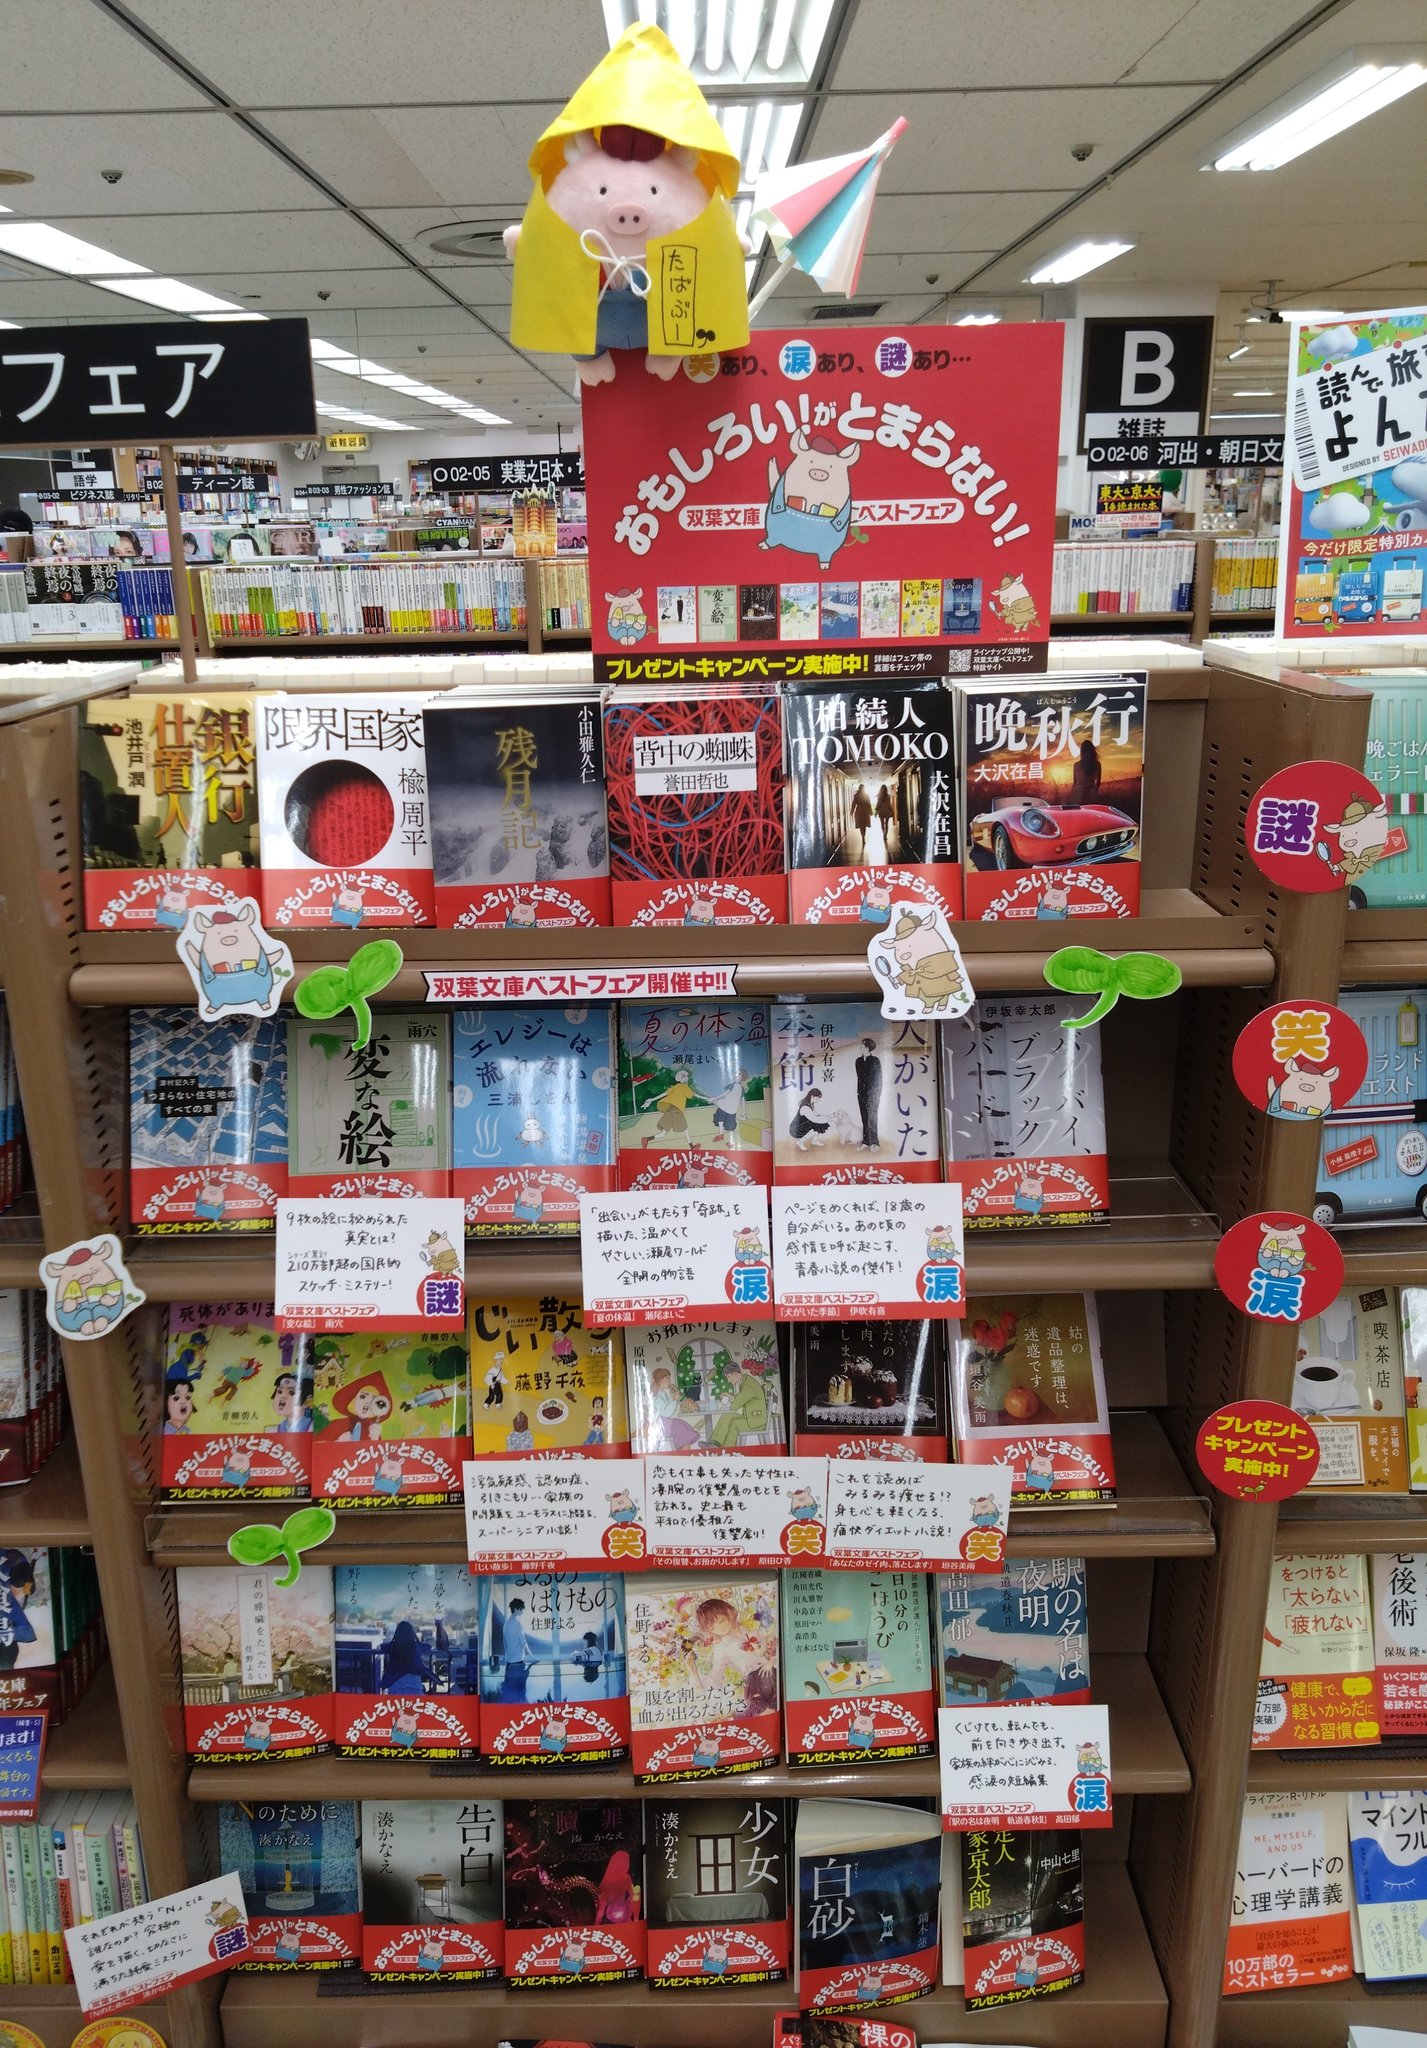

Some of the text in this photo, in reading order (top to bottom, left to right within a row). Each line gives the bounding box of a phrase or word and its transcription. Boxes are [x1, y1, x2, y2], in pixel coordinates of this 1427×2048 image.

[668, 249, 696, 342] たばぶー
[1120, 330, 1175, 406] B
[2, 343, 226, 423] フェア
[1118, 418, 1166, 438] 雑誌
[328, 437, 367, 448] 避難器具
[1157, 440, 1284, 466] 河出・朝日文
[1342, 457, 1372, 473] DESIGNED
[1372, 455, 1380, 464] BY
[73, 474, 98, 488] 語学
[191, 476, 256, 491] ティーン誌
[308, 486, 330, 495] B03-03
[334, 484, 391, 496] 男性ファッション誌
[70, 490, 115, 500] ビジネス誌
[436, 517, 477, 527] CYANMAN
[686, 501, 957, 528] 双葉文庫 ベストフェア
[1303, 533, 1427, 557] 今だけ限定特別カ
[606, 655, 869, 681] プレゼントキャンペーン実施中!
[873, 653, 933, 664] 詳細はフェア帯の
[873, 662, 926, 673] 裏面をチェック!
[973, 655, 1034, 664] 双葉文庫ベストフェア
[815, 696, 927, 733] 相続人
[263, 706, 426, 752] 限界国家
[975, 692, 1139, 761] 晩秋行
[577, 705, 597, 785] 小田雅久仁
[635, 735, 755, 768] 背中の蜘蛛
[792, 730, 950, 766] TOMOKO
[149, 703, 197, 839] 仕置人
[195, 706, 256, 824] 銀行
[974, 762, 1044, 783] 大沢在昌
[495, 726, 542, 851] 残月記
[663, 772, 730, 793] 誉田哲也
[929, 770, 952, 857] 大沢在昌
[1256, 799, 1318, 855] 謎
[433, 973, 728, 999] 双葉文庫ベストフェア開催中!!
[985, 1004, 1057, 1018] 伊坂幸太郎
[408, 1025, 438, 1039] 雨穴
[469, 1019, 593, 1058] エレジーは
[639, 1006, 770, 1058] 夏の体温
[1273, 1010, 1330, 1062] 笑
[776, 1008, 815, 1093] 季節
[820, 1023, 836, 1083] 伊吹有喜
[158, 1078, 197, 1088] 津村記久子
[1010, 1032, 1042, 1149] ブラック
[148, 1088, 237, 1101] つまらない住宅地の
[337, 1034, 398, 1168] 変な絵
[487, 1092, 579, 1108] 三浦しをん
[164, 1104, 214, 1116] すべての家
[591, 1201, 741, 1223] 「出会い」がもたらす「奇跡」を
[785, 1200, 926, 1215] ページをめくれば、18歳の
[286, 1211, 408, 1226] 9枚の絵に秘められた
[786, 1220, 906, 1237] 自分がいる。あの頃の
[345, 1230, 396, 1246] 真実とは?
[596, 1226, 689, 1243] 描いた、温かくて
[617, 1267, 695, 1287] 全開の物語
[795, 1260, 904, 1279] 青春小説の傑作!
[733, 1268, 768, 1303] 涙
[926, 1266, 960, 1302] 涙
[425, 1280, 462, 1315] 謎
[595, 1296, 685, 1310] 双葉文庫ベストフェア
[784, 1293, 875, 1305] 双葉文庫ベストフェア
[285, 1305, 376, 1317] 双葉文庫ベストフェア
[592, 1309, 686, 1324] 『夏の体温』 瀬尾まいこ
[780, 1305, 886, 1318] 『犬がいた季節』 伊吹有喜
[282, 1318, 344, 1329] 『変な絵』 雨穴
[1067, 1325, 1084, 1354] 姑の
[1023, 1327, 1043, 1388] 迷惑です
[1373, 1321, 1391, 1389] 喫茶店
[1046, 1327, 1069, 1410] 遺品整理は、
[514, 1371, 586, 1391] 藤野千夜
[969, 1363, 987, 1423] 垣谷美雨
[221, 1410, 259, 1421] 青柳碧人
[1216, 1415, 1307, 1438] プレゼント
[1203, 1435, 1315, 1461] キャンペーン
[1390, 1425, 1400, 1457] 至福の
[1380, 1427, 1391, 1477] エッセイで
[652, 1464, 799, 1480] 恋も仕事も失った女性は、
[1223, 1456, 1289, 1478] 実施中!
[471, 1473, 589, 1489] 浮気疑惑、認知症、
[836, 1472, 925, 1485] これを読めば
[654, 1500, 747, 1514] 訪れる。史上最も
[478, 1525, 579, 1538] スーパーシニア小説!
[654, 1514, 734, 1528] 平和で優雅な
[832, 1523, 952, 1538] 痛快ダイエット小説!
[610, 1528, 645, 1559] 笑
[787, 1524, 824, 1555] 笑
[967, 1531, 1003, 1561] 笑
[477, 1551, 563, 1561] 双葉文庫ベストフェア
[655, 1546, 742, 1557] 双葉文庫ベストフェア
[758, 1556, 792, 1566] 原田ひ香
[833, 1549, 920, 1560] 双葉文庫ベストフェア
[474, 1561, 556, 1572] 『じい散歩』 藤野千夜
[791, 1570, 823, 1579] 江國香織
[829, 1559, 976, 1571] 『あなたのゼイ肉、落とします』 垣谷美雨
[1281, 1565, 1350, 1582] をつけると
[793, 1582, 824, 1592] 角田光代
[1016, 1560, 1050, 1629] 夜明
[1281, 1587, 1367, 1608] 「太らない」
[529, 1586, 618, 1615] ばけもの
[793, 1606, 824, 1616] 中島京子
[253, 1578, 269, 1681] 君の膵臓をたべたい
[530, 1617, 576, 1631] 住野よる
[794, 1620, 823, 1629] 原田マハ
[1051, 1558, 1086, 1681] 駅の名は
[1283, 1614, 1370, 1635] 「疲れない」
[634, 1603, 652, 1664] 住野よる
[795, 1632, 818, 1641] 森浩美
[796, 1643, 830, 1654] 吉本ばなな
[644, 1684, 736, 1707] 腹を割ったら
[1291, 1681, 1341, 1699] 健康で、
[638, 1699, 749, 1725] 血が出るだけさ
[1292, 1702, 1375, 1721] 軽いからだに
[955, 1719, 1055, 1735] くじけても、転んでも、
[1293, 1722, 1354, 1741] なる習慣
[971, 1737, 1066, 1752] 前を向き歩き出す。
[1075, 1779, 1108, 1811] 涙
[950, 1804, 1032, 1815] 双葉文庫ベストフェア
[257, 1832, 315, 1847] 湊かなえ
[376, 1810, 395, 1875] 湊かなえ
[455, 1803, 497, 1888] 告白
[661, 1811, 680, 1880] 湊かなえ
[738, 1801, 780, 1889] 少女
[1253, 1830, 1316, 1844] ME, MYSELF,
[1266, 1843, 1303, 1854] AND US
[1039, 1848, 1081, 1871] 中山七里
[807, 1857, 856, 1942] 白砂
[1227, 1953, 1294, 1976] 10万部の
[1228, 1968, 1315, 1989] ベストセラー
